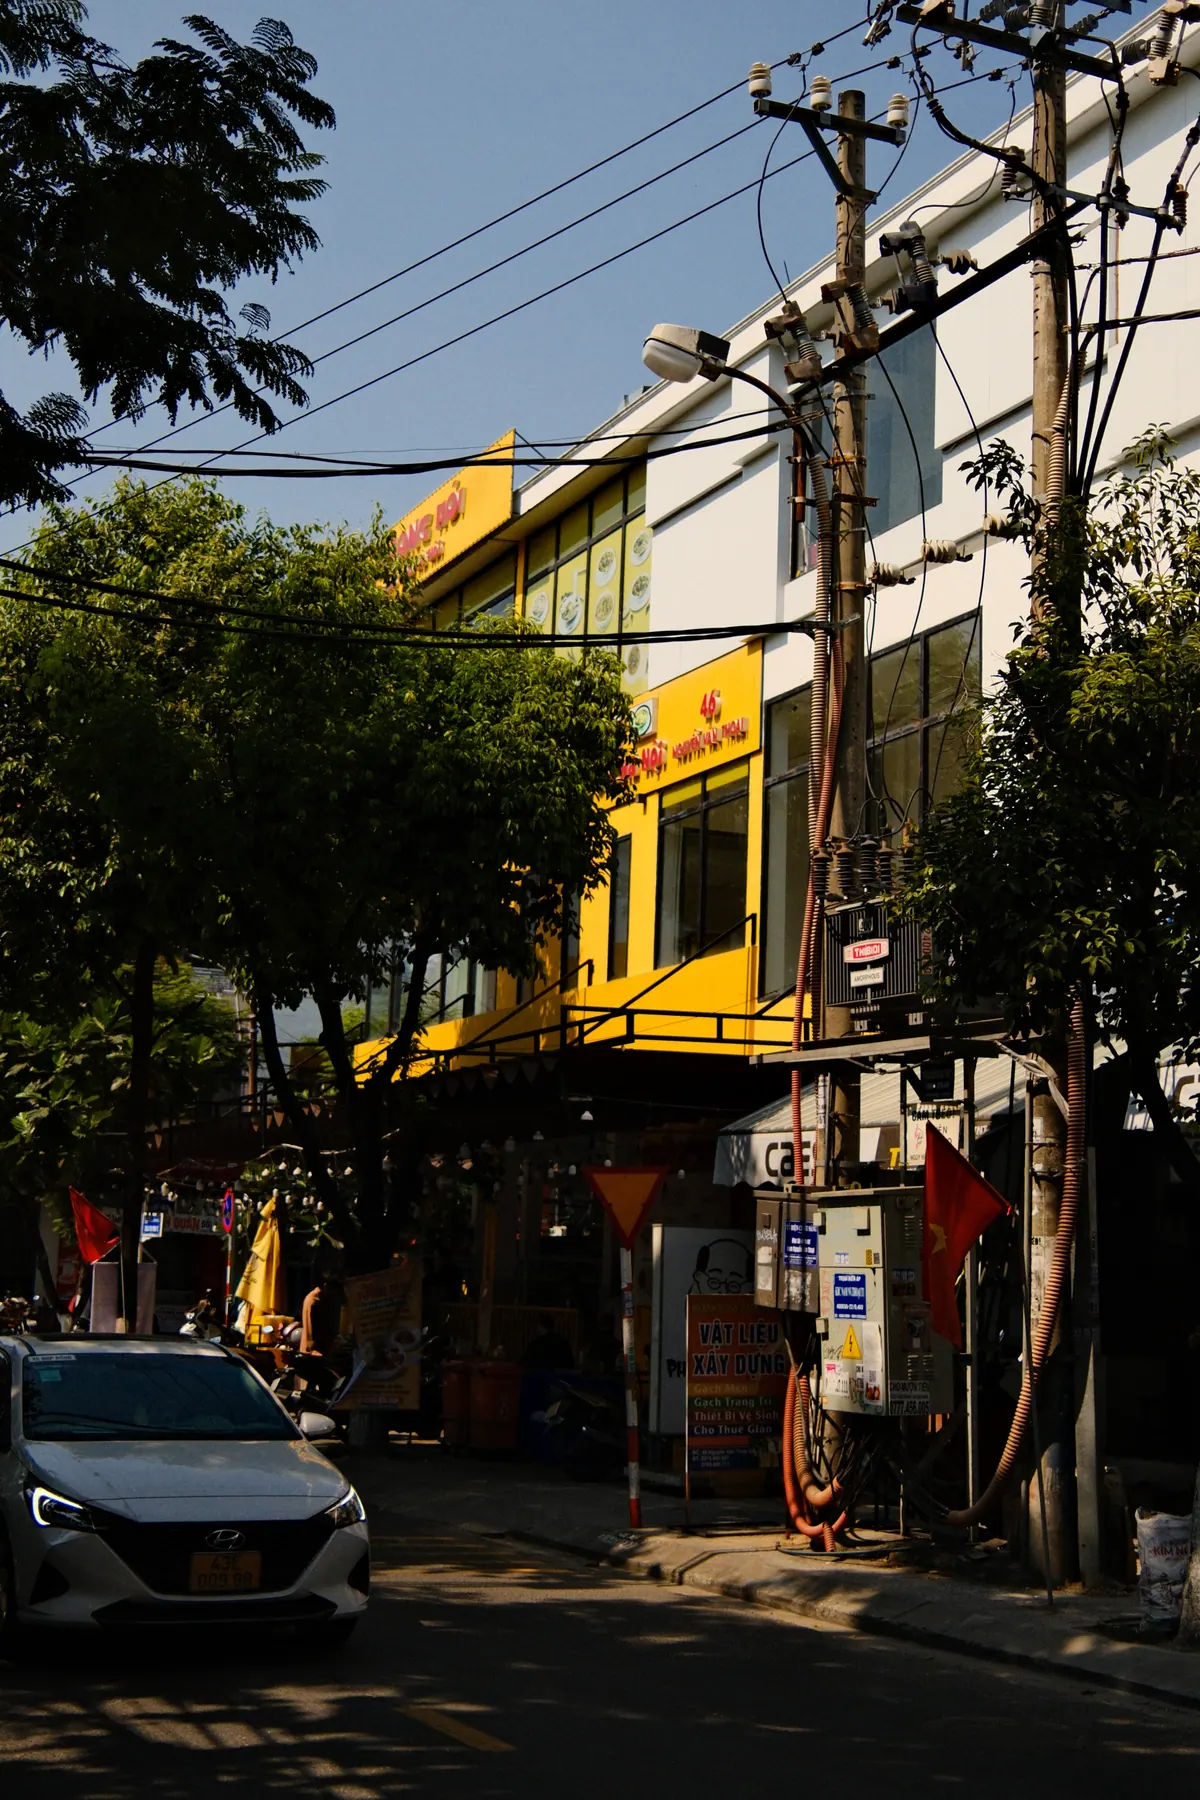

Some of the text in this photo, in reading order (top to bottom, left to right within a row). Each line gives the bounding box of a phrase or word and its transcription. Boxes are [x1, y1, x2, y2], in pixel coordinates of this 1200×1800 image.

[700, 689, 721, 718] 46
[699, 1317, 780, 1349] VẬT LIỆU
[692, 1348, 785, 1380] XÂY DỰNG
[694, 1397, 721, 1408] Gạch
[725, 1397, 755, 1408] Trang
[694, 1425, 715, 1435] Cho
[1153, 1546, 1174, 1557] KIM
